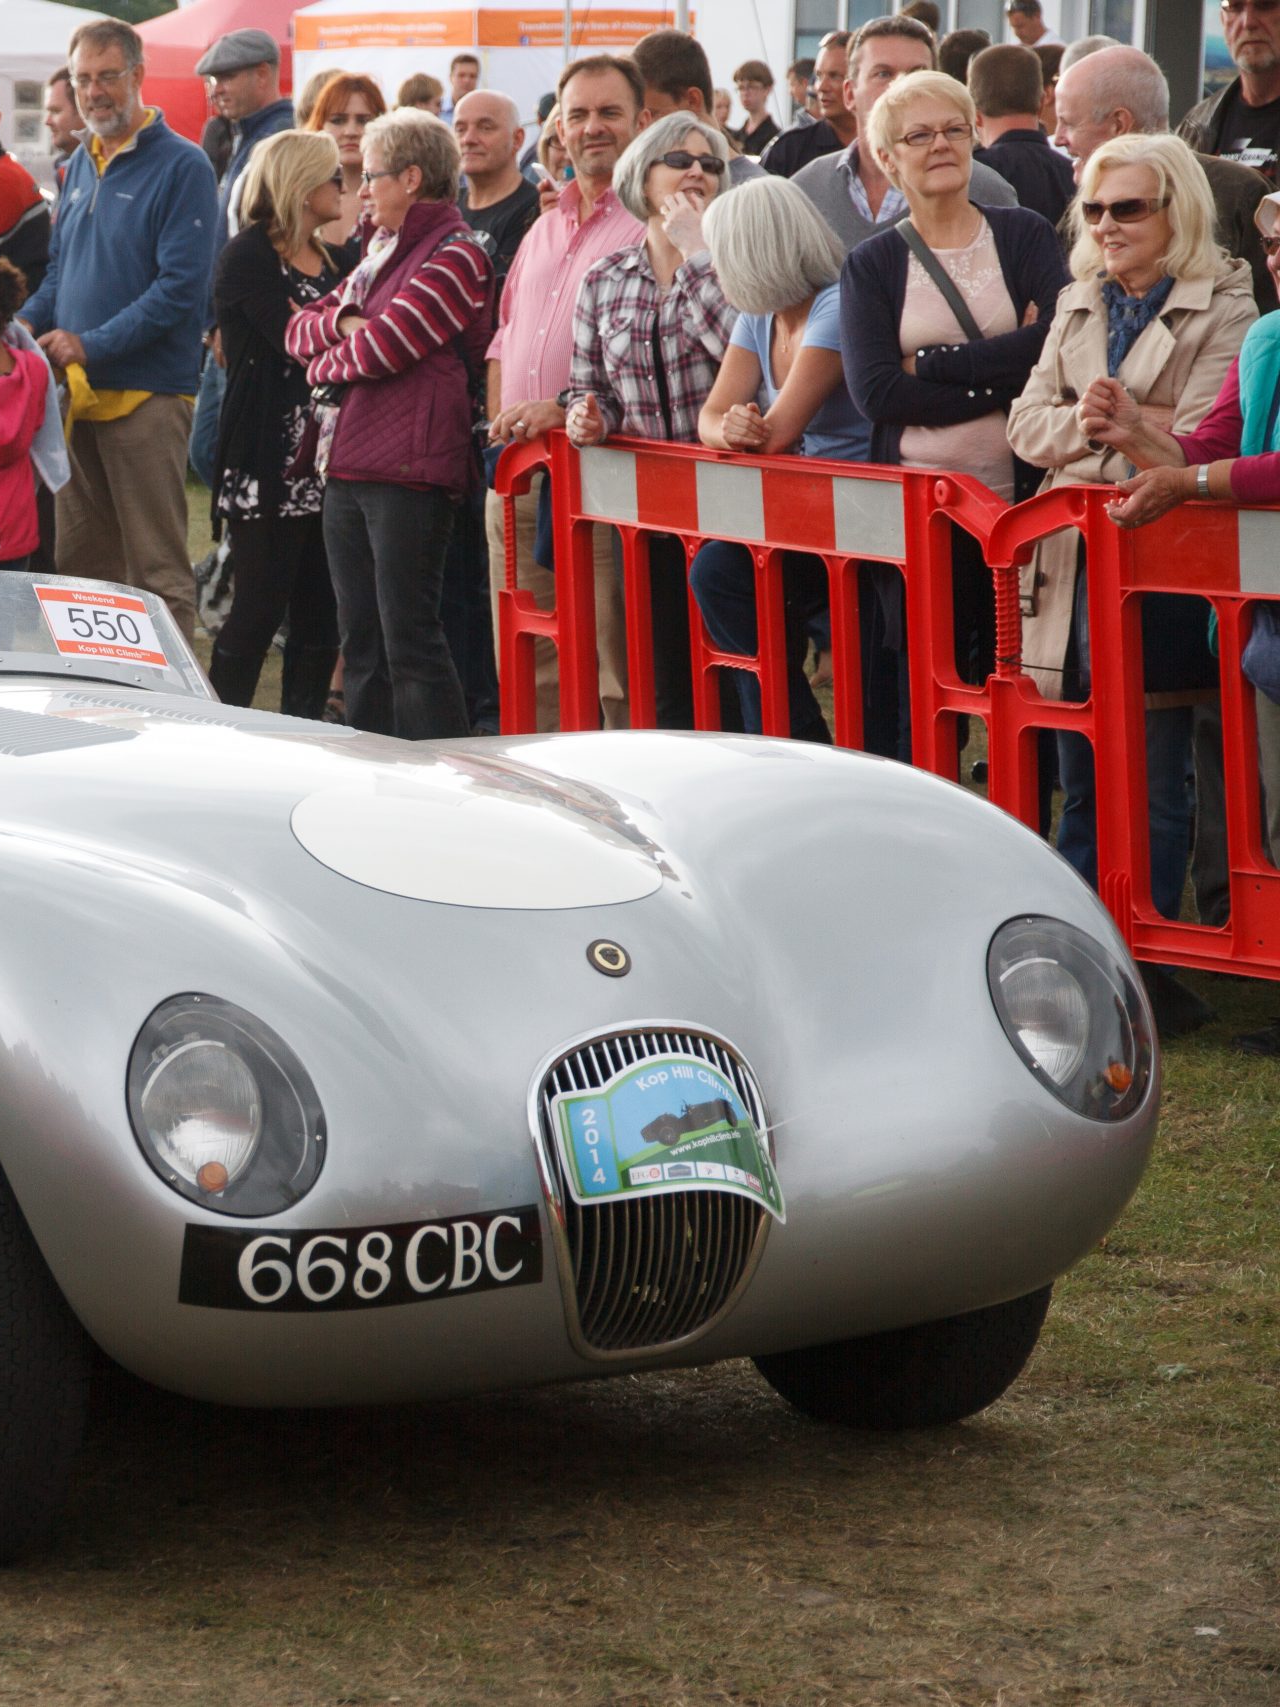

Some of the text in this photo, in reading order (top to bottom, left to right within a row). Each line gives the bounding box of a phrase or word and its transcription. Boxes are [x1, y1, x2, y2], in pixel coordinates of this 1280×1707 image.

[72, 593, 115, 605] Weekend
[67, 607, 141, 645] 550
[77, 644, 98, 655] Kop
[99, 645, 114, 655] Hill
[116, 648, 142, 659] Climb
[635, 1065, 733, 1103] Kop Hill Climb
[581, 1108, 607, 1185] 2014
[236, 1215, 524, 1305] 668 CBC
